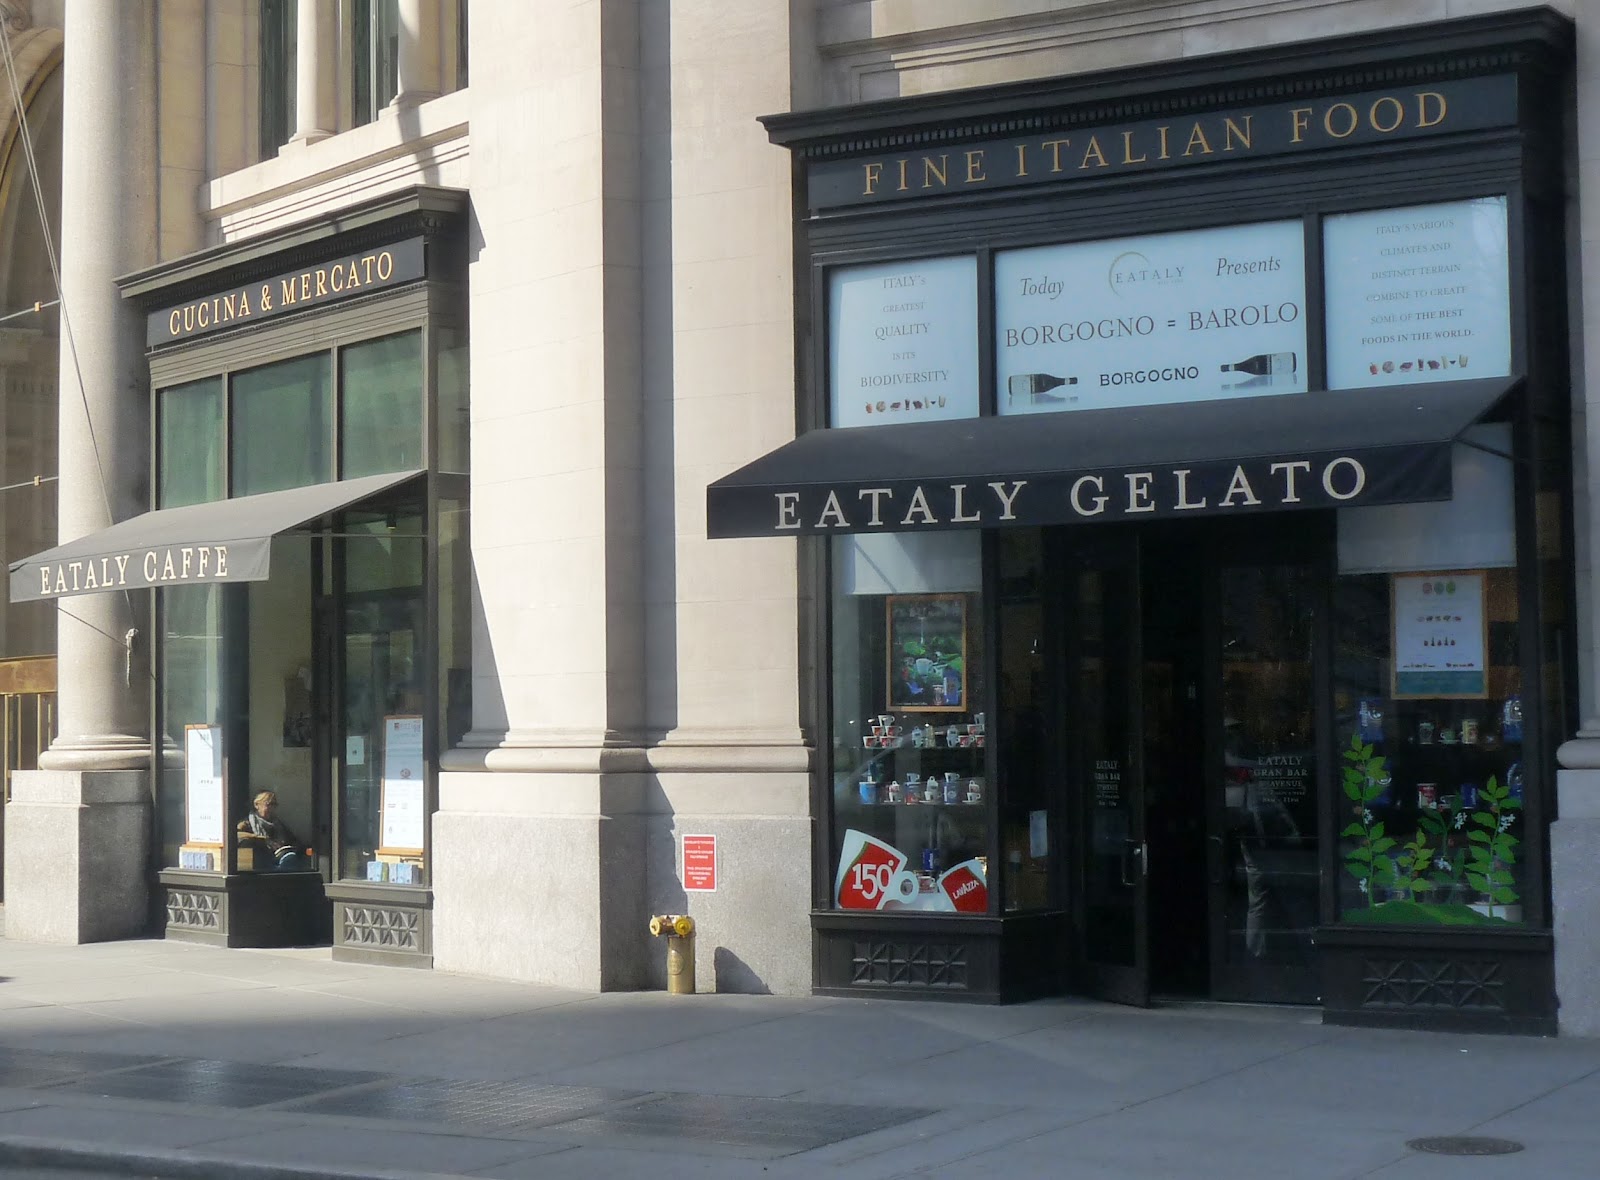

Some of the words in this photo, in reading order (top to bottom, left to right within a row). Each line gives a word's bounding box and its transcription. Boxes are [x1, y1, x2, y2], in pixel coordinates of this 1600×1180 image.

[863, 150, 987, 196] FINE
[1015, 116, 1254, 178] ITALIAN
[1289, 91, 1448, 144] FOOD
[1412, 219, 1455, 231] VARIOUS
[1380, 245, 1427, 257] CLIMATES
[1430, 242, 1451, 252] AND
[1115, 266, 1185, 284] EATALY
[1216, 256, 1281, 277] Presents
[1371, 268, 1417, 280] DISTINCT
[1420, 264, 1462, 275] TERRAIN
[169, 290, 250, 336] CUCINA
[260, 285, 273, 312] &
[280, 251, 393, 305] MERCATO
[1020, 277, 1064, 300] Today
[1366, 290, 1411, 302] COMBINE
[1415, 290, 1428, 299] TO
[1430, 286, 1467, 296] CREATE
[883, 302, 925, 313] GREATEST
[1006, 315, 1154, 347] BORGOGNO
[1188, 302, 1298, 330] BAROLO
[1370, 315, 1397, 325] SOME
[1400, 312, 1413, 321] OF
[1416, 311, 1436, 321] THE
[1439, 309, 1464, 319] BEST
[875, 323, 930, 341] QUALITY
[1361, 335, 1396, 346] FOODS
[1398, 334, 1410, 342] IN
[1411, 332, 1432, 341] THE
[1434, 329, 1476, 339] WORLD.
[892, 353, 901, 361] IS
[902, 352, 916, 361] ITS
[860, 370, 950, 388] BIODIVERSITY
[1100, 366, 1199, 386] BORGOGNO
[774, 480, 1028, 530] EATALY
[1070, 456, 1366, 517] GELATO
[40, 554, 130, 595] EATALY
[143, 546, 228, 583] CAFFE
[1258, 756, 1303, 765] EATALY
